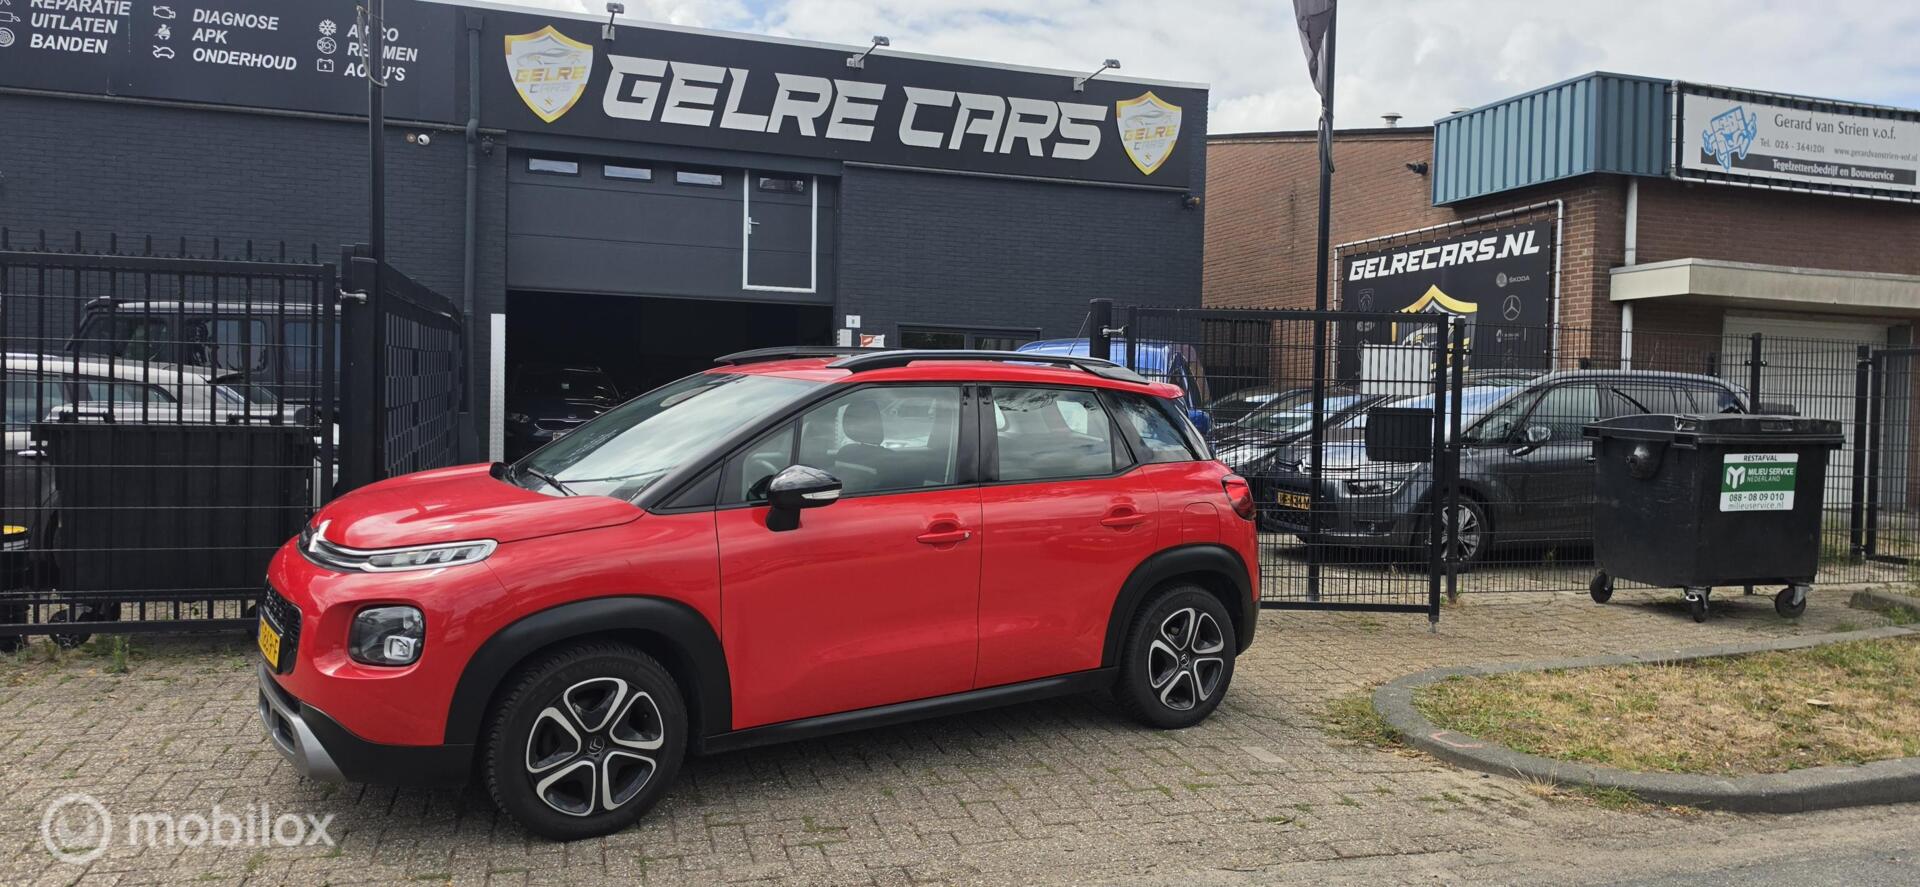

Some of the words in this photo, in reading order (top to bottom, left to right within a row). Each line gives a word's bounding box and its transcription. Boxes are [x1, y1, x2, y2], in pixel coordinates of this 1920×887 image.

[30, 0, 131, 16] REPARATIE
[31, 12, 118, 34] UITLATEN
[192, 8, 280, 31] DIAGNOSE
[30, 33, 108, 54] BANDEN
[191, 27, 228, 44] APK
[192, 47, 298, 71] ONDERHOUD
[602, 53, 887, 142] GELRE
[898, 86, 1109, 161] CARS
[1774, 113, 1812, 131] Gerard
[1815, 121, 1834, 134] van
[1838, 121, 1869, 137] Strien
[1872, 126, 1897, 140] v.o.f.
[1772, 158, 1838, 177] Tegelzettersbedrijf
[1839, 168, 1850, 177] en
[1851, 166, 1895, 181] Bouwservice
[1349, 230, 1540, 282] GELRECARS.NL
[1743, 454, 1777, 462] RESTAFVAL
[1747, 468, 1768, 476] MILIEU
[1768, 467, 1794, 476] SERVICE
[1729, 493, 1742, 502] 088
[1748, 493, 1758, 501] 08
[1759, 493, 1768, 501] 09
[1770, 492, 1785, 501] 010
